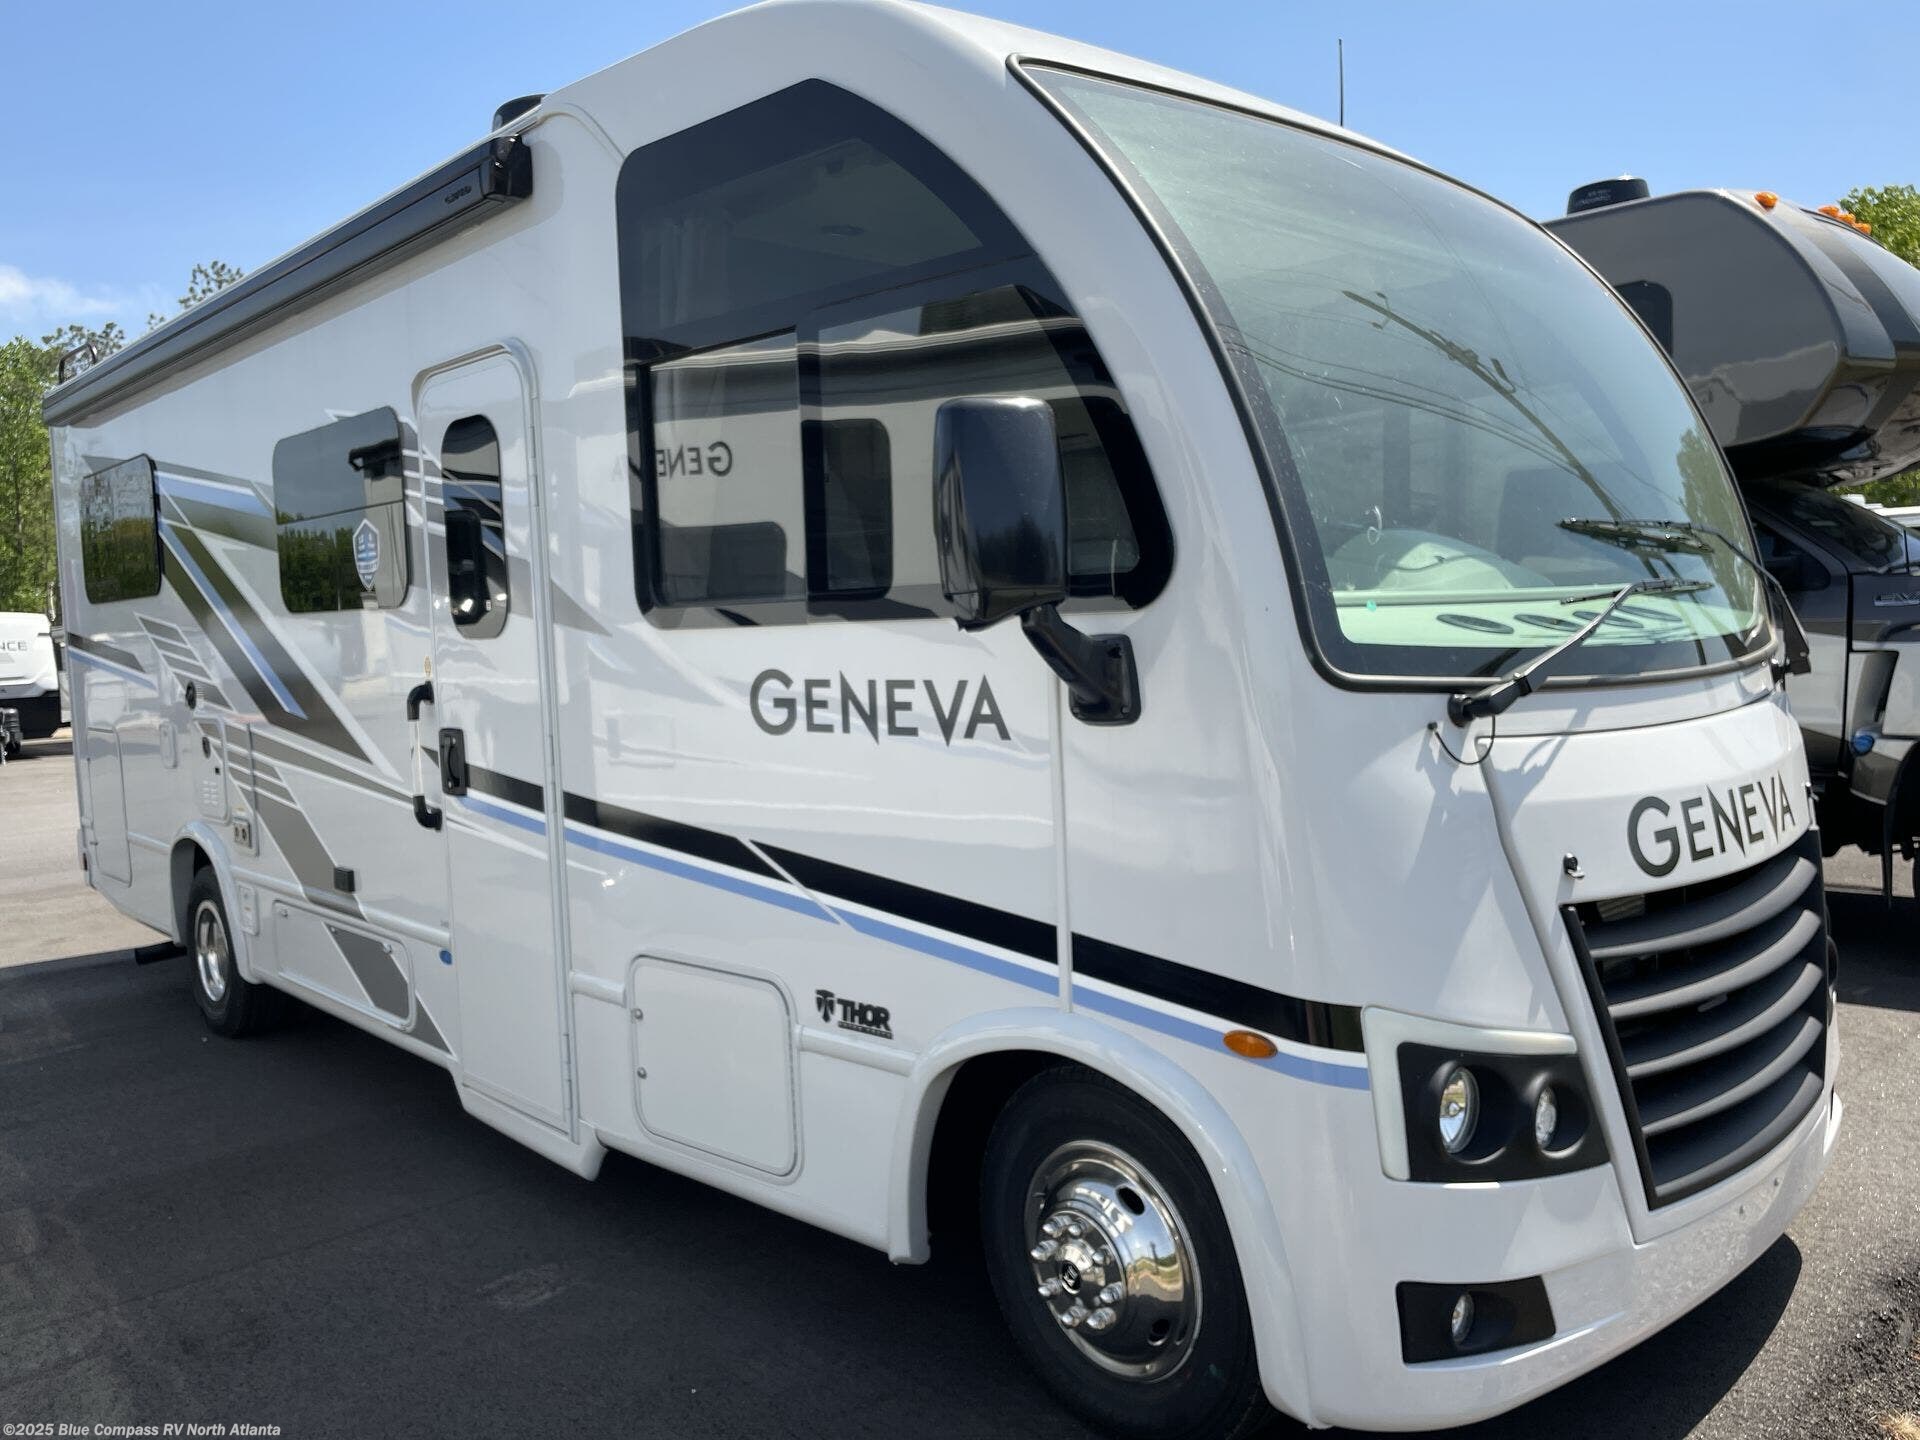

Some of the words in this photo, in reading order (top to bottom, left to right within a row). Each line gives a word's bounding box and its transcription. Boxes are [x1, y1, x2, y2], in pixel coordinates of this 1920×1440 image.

[749, 668, 1012, 747] GENEVA
[1627, 770, 1796, 878] GENEVA
[837, 998, 892, 1031] THOR
